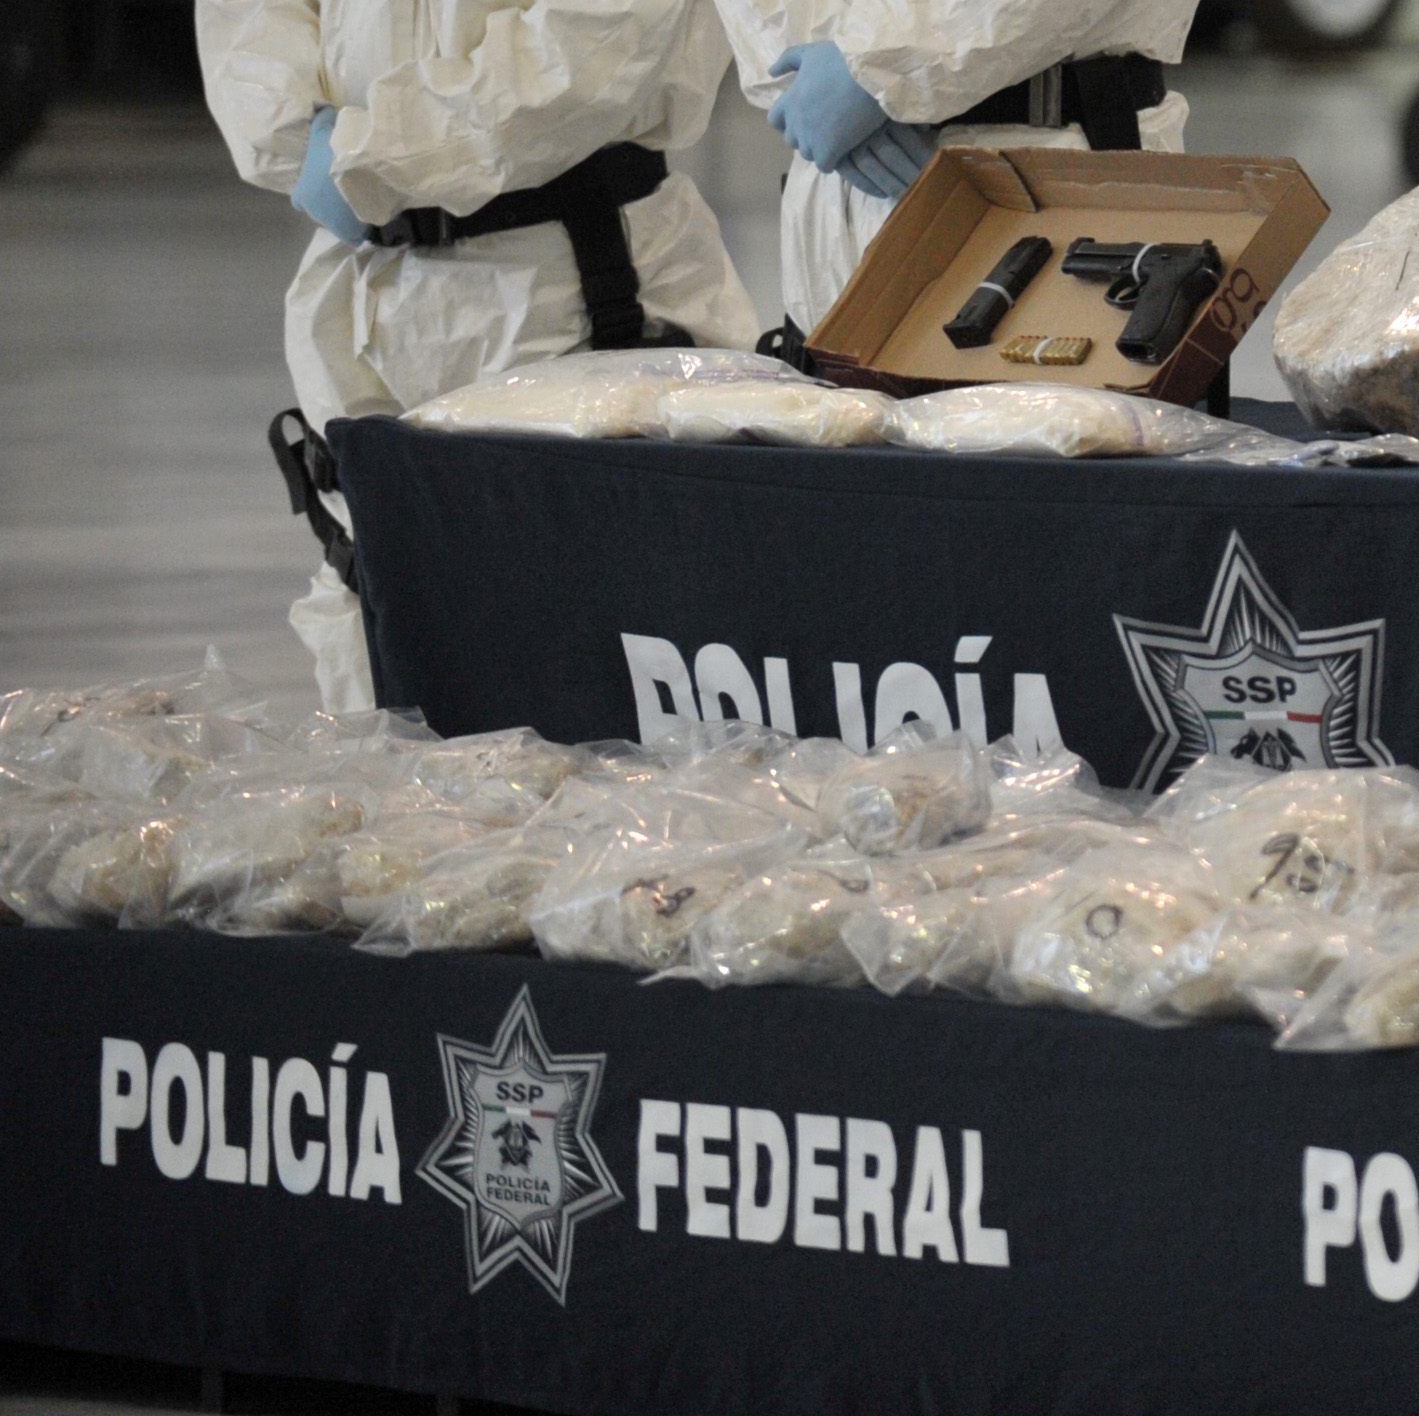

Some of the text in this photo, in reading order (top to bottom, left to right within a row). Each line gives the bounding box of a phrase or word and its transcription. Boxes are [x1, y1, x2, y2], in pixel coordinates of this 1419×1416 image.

[1222, 675, 1297, 703] SSP
[495, 1081, 544, 1103] SSP
[100, 1036, 1010, 1267] POLICÍA FEDERAL
[487, 1186, 551, 1206] FEDERAL
